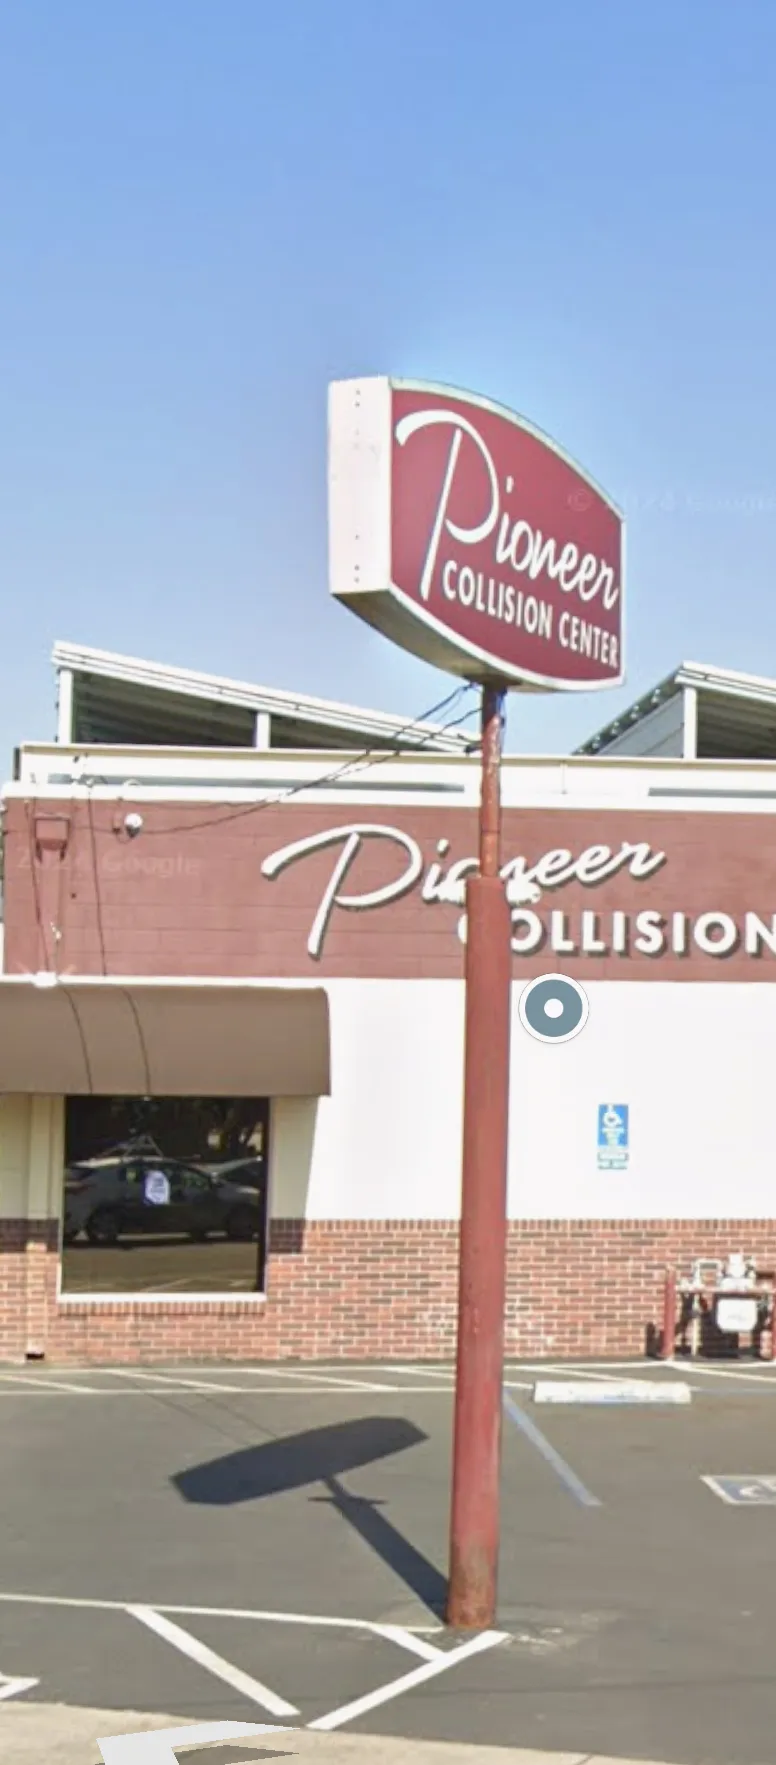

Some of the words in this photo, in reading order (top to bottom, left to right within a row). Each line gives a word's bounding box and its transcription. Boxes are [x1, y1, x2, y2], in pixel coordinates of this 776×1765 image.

[395, 409, 619, 610] Pioneer
[442, 559, 553, 640] COLLISION
[558, 611, 619, 670] CENTER
[457, 908, 776, 957] OLLISION
